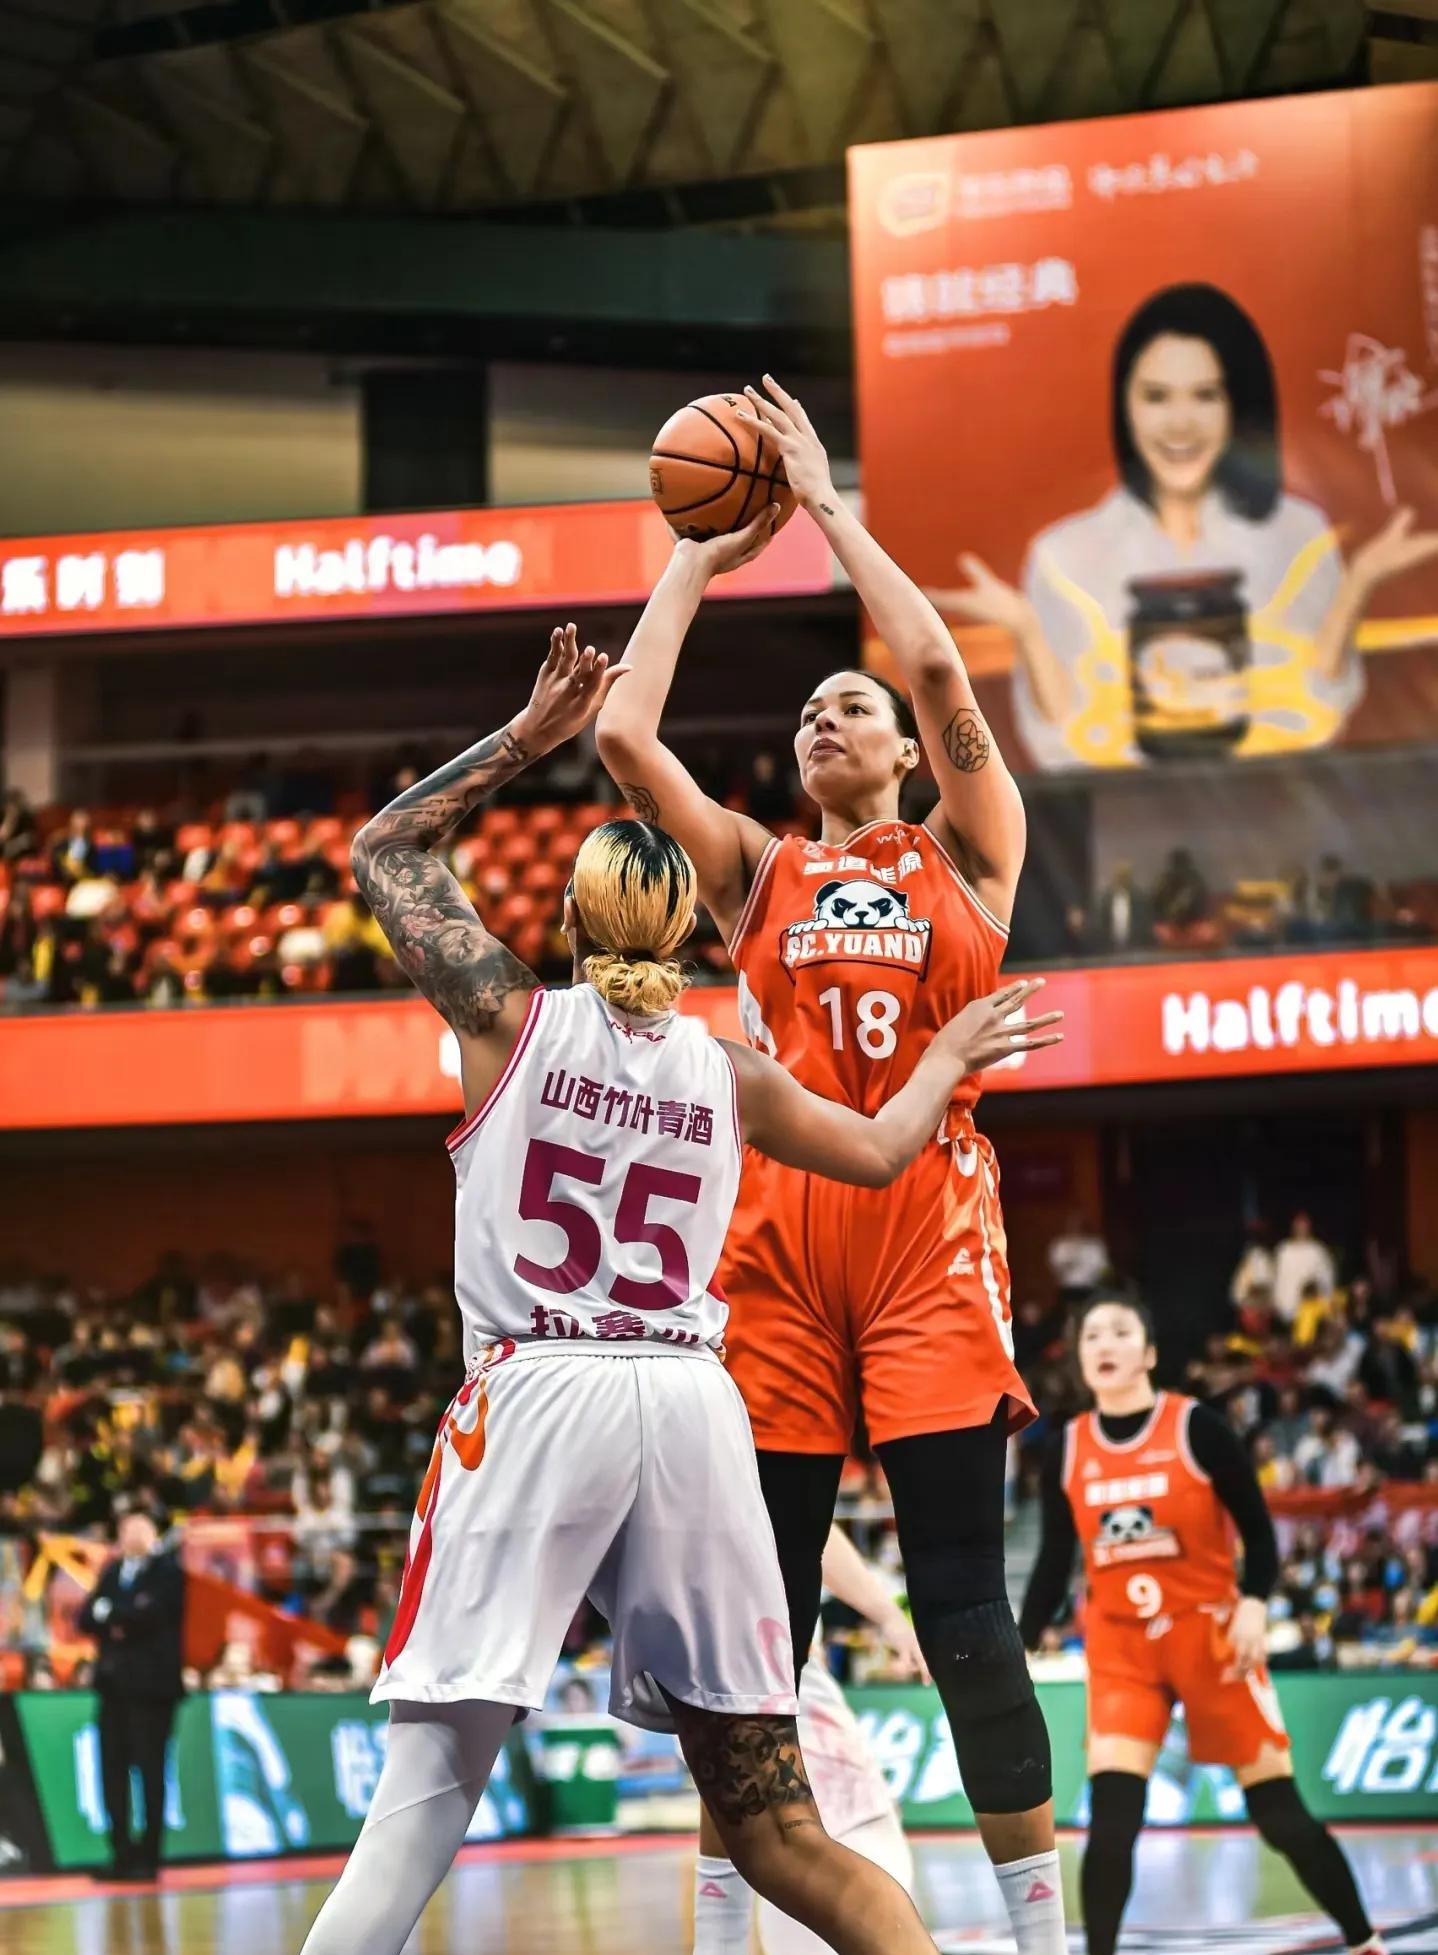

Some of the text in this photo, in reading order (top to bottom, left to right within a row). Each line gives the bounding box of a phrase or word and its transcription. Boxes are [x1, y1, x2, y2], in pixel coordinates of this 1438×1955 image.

[274, 534, 521, 597] Halftime
[819, 986, 900, 1060] 18
[540, 1068, 714, 1147] 山西竹叶青酒
[513, 1138, 702, 1311] 55
[1126, 1573, 1163, 1619] 9
